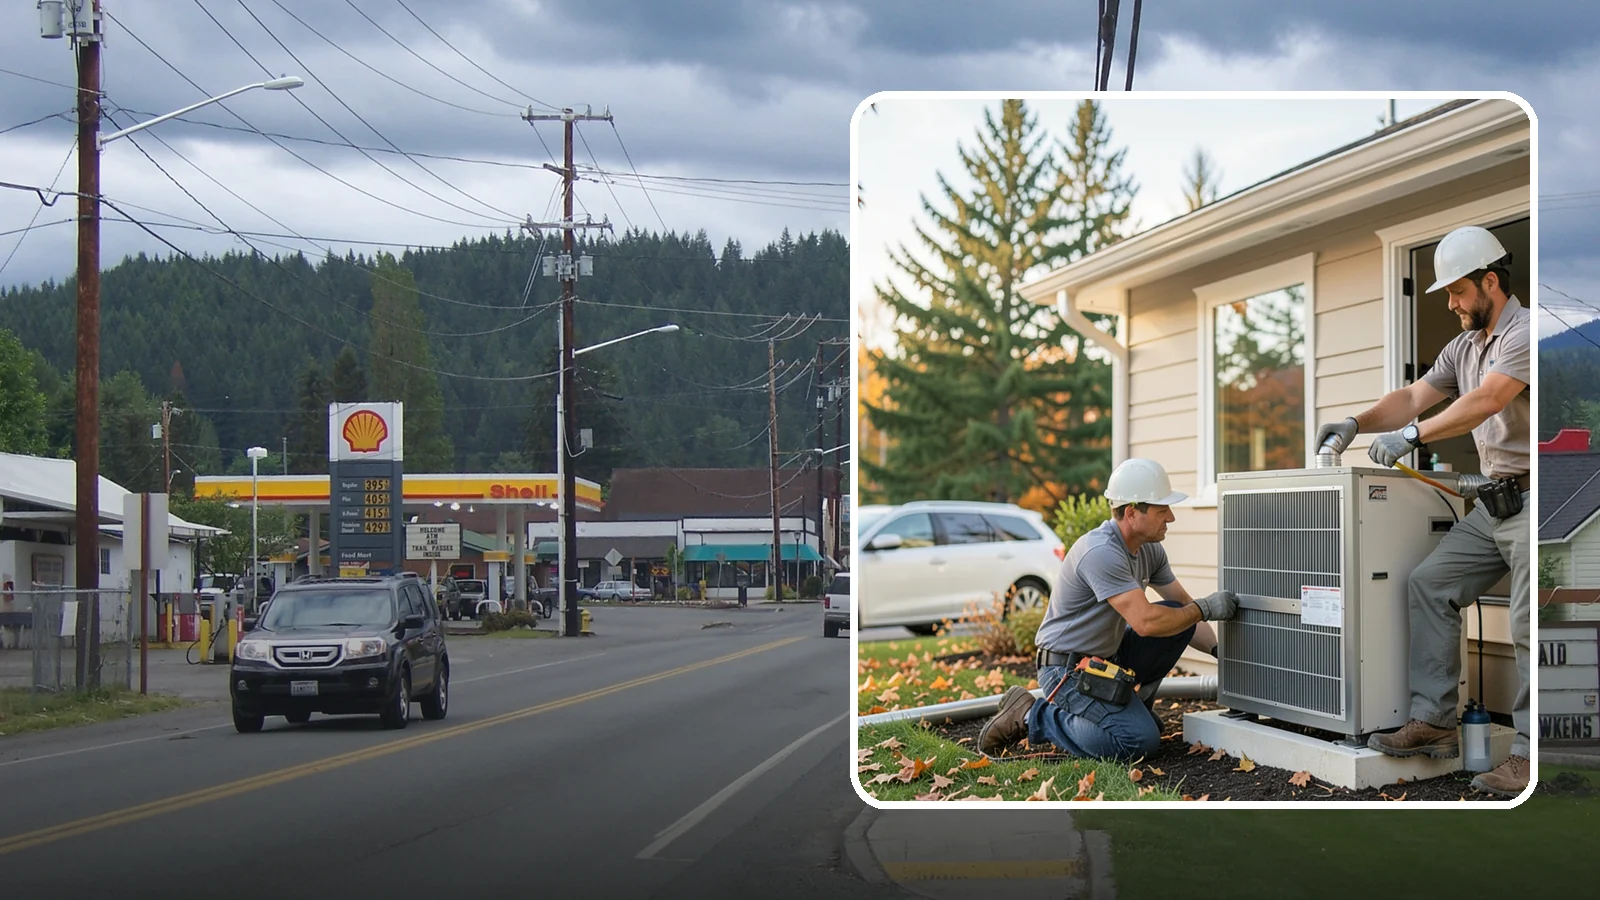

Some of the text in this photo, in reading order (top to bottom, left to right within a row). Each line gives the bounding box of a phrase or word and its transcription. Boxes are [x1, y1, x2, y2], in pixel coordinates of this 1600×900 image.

[365, 480, 384, 490] 395
[490, 484, 547, 499] Shell
[365, 494, 384, 504] 405
[365, 508, 383, 518] 415
[365, 522, 383, 532] 429
